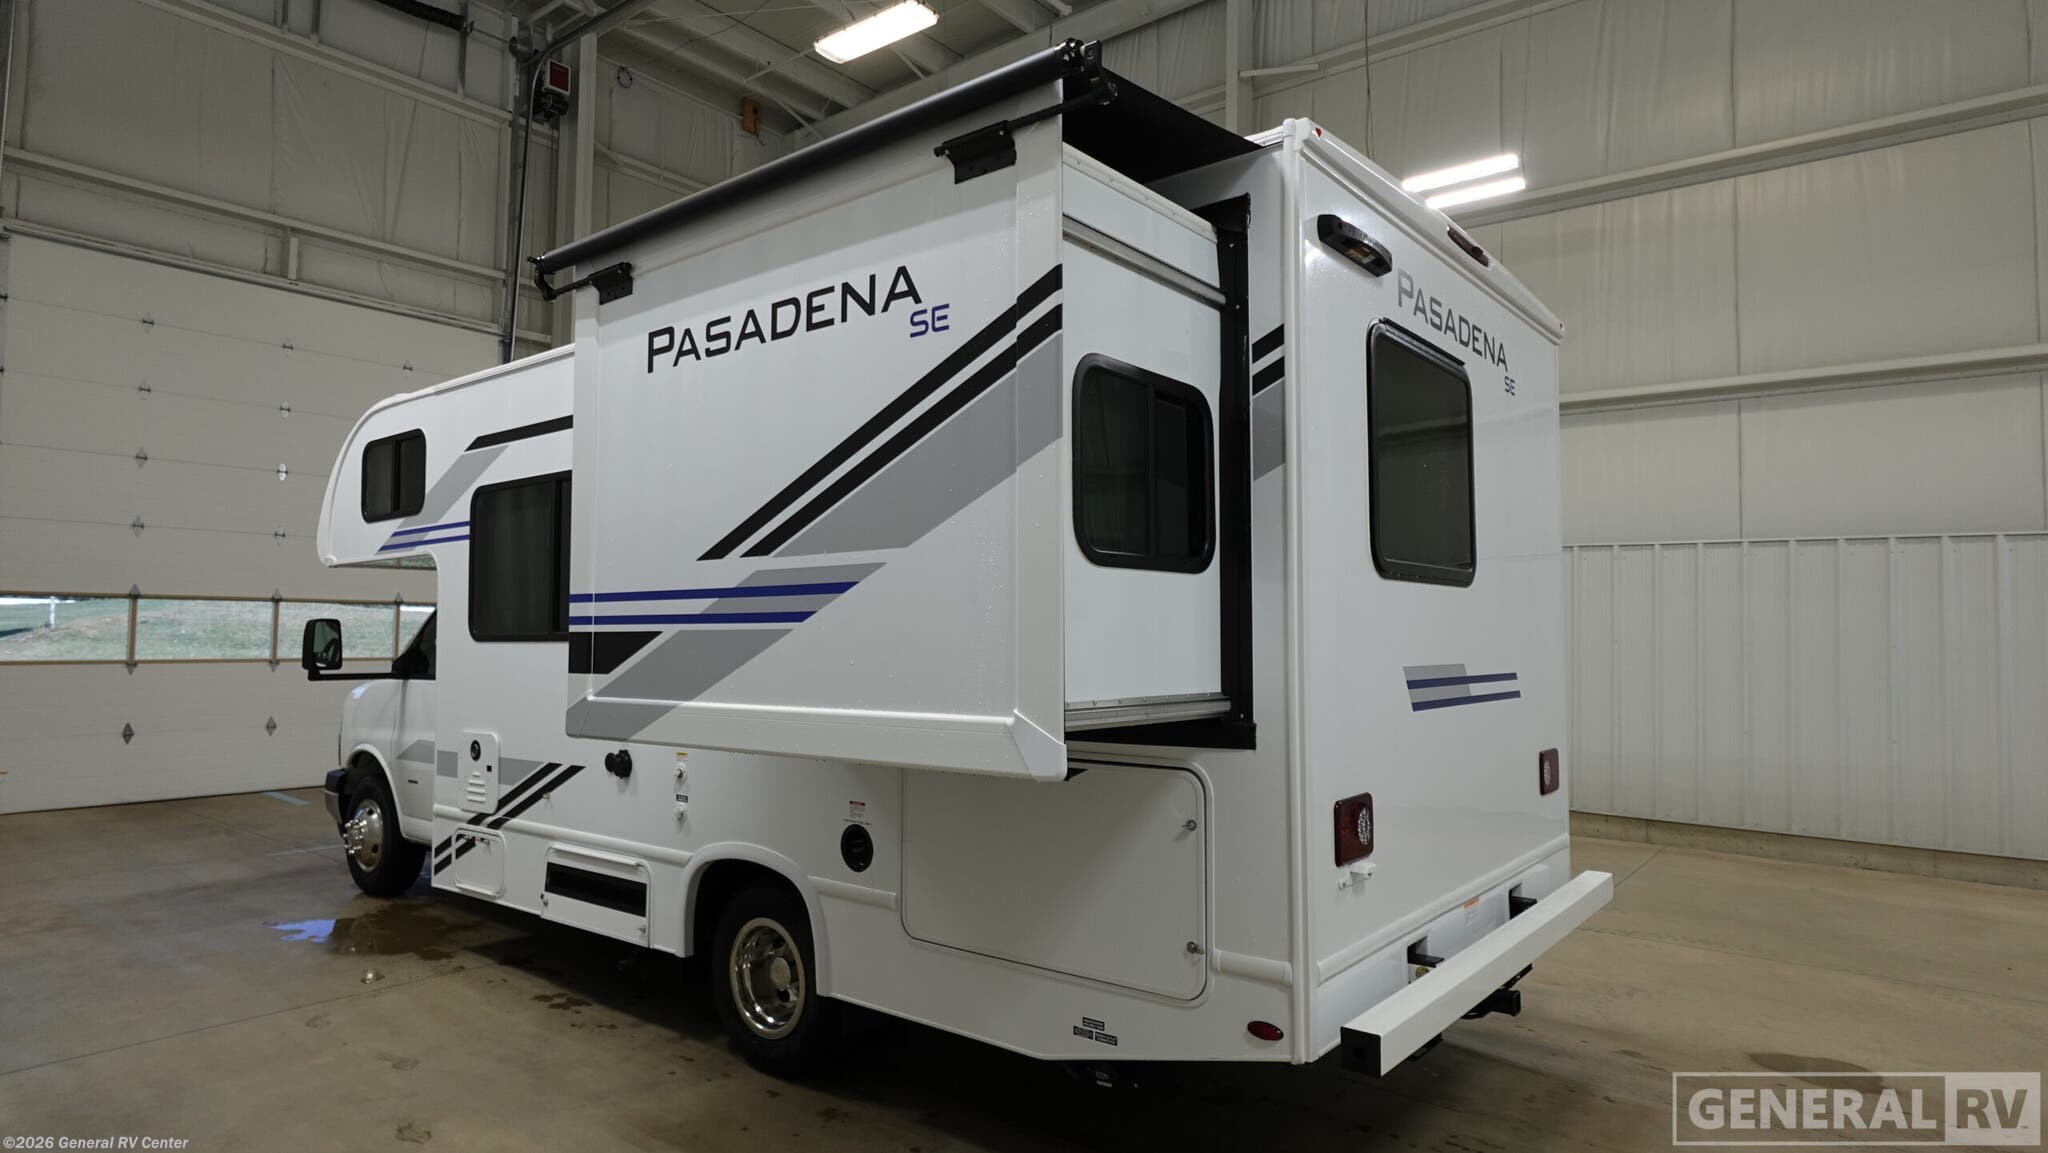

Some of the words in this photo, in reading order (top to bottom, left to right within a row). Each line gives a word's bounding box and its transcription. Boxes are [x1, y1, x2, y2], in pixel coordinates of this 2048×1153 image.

[647, 265, 923, 374] PASADENA
[909, 303, 950, 338] SE
[1397, 268, 1508, 373] PASADENA
[1504, 375, 1516, 397] SE
